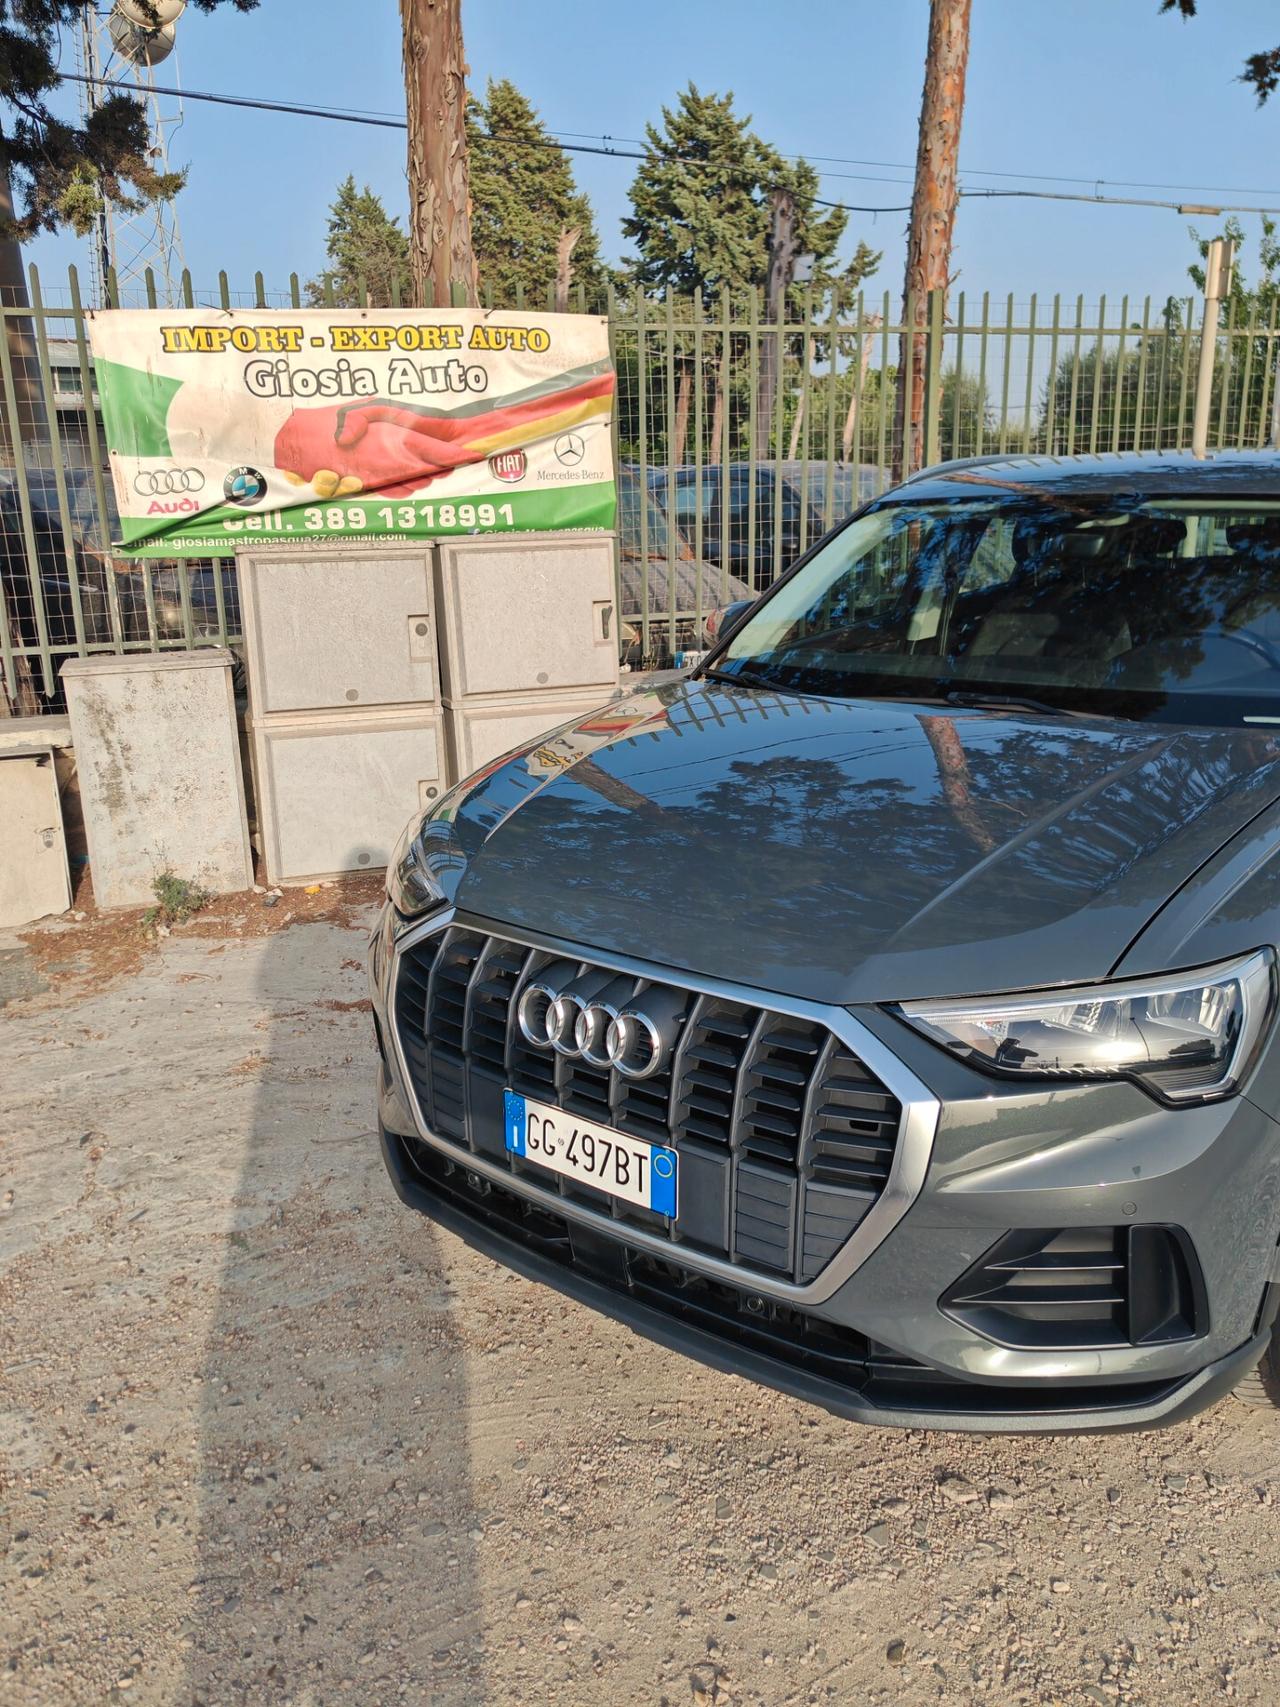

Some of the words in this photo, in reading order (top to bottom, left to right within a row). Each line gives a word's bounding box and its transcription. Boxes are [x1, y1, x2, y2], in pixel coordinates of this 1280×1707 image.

[160, 326, 303, 353] IMPORT
[328, 325, 463, 352] EXPORT
[468, 325, 551, 352] AUTO
[244, 358, 378, 398] Giosia
[388, 358, 488, 395] Auto
[227, 467, 262, 482] BMW
[497, 454, 520, 473] FIAT
[147, 498, 199, 514] Audi
[304, 507, 367, 530] 389
[377, 503, 514, 530] 1318991
[527, 1113, 556, 1156] GG
[565, 1129, 648, 1193] 497BT
